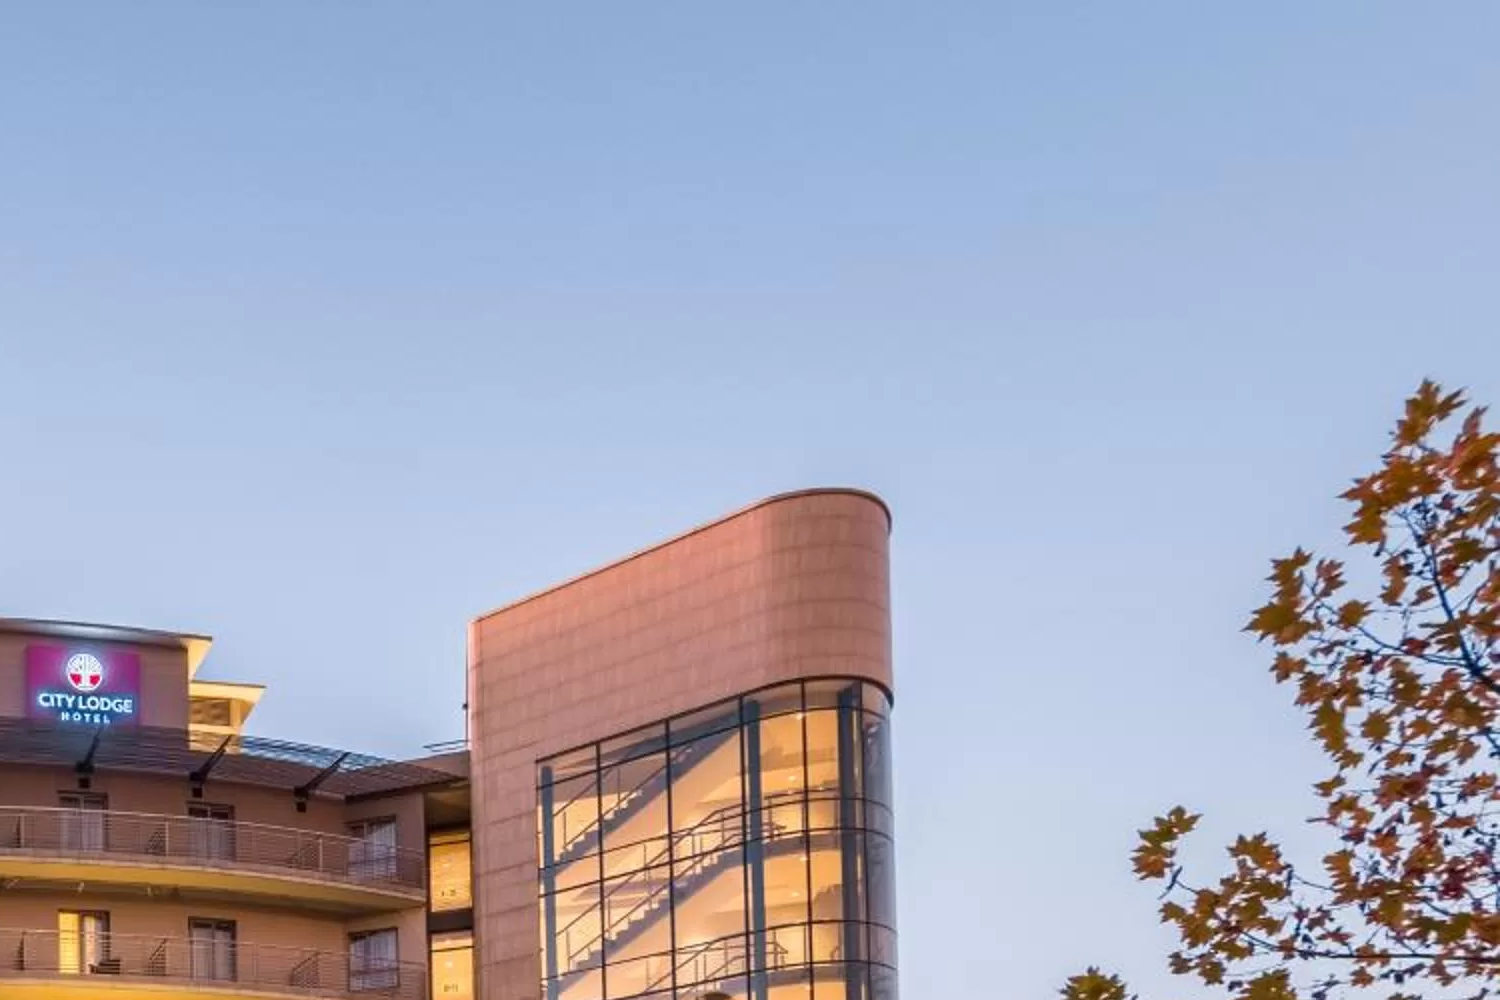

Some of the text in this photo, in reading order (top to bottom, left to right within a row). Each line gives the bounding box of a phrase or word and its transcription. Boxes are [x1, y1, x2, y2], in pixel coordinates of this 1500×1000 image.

[38, 693, 133, 713] CITY LODGE
[61, 711, 110, 724] HOTEL
